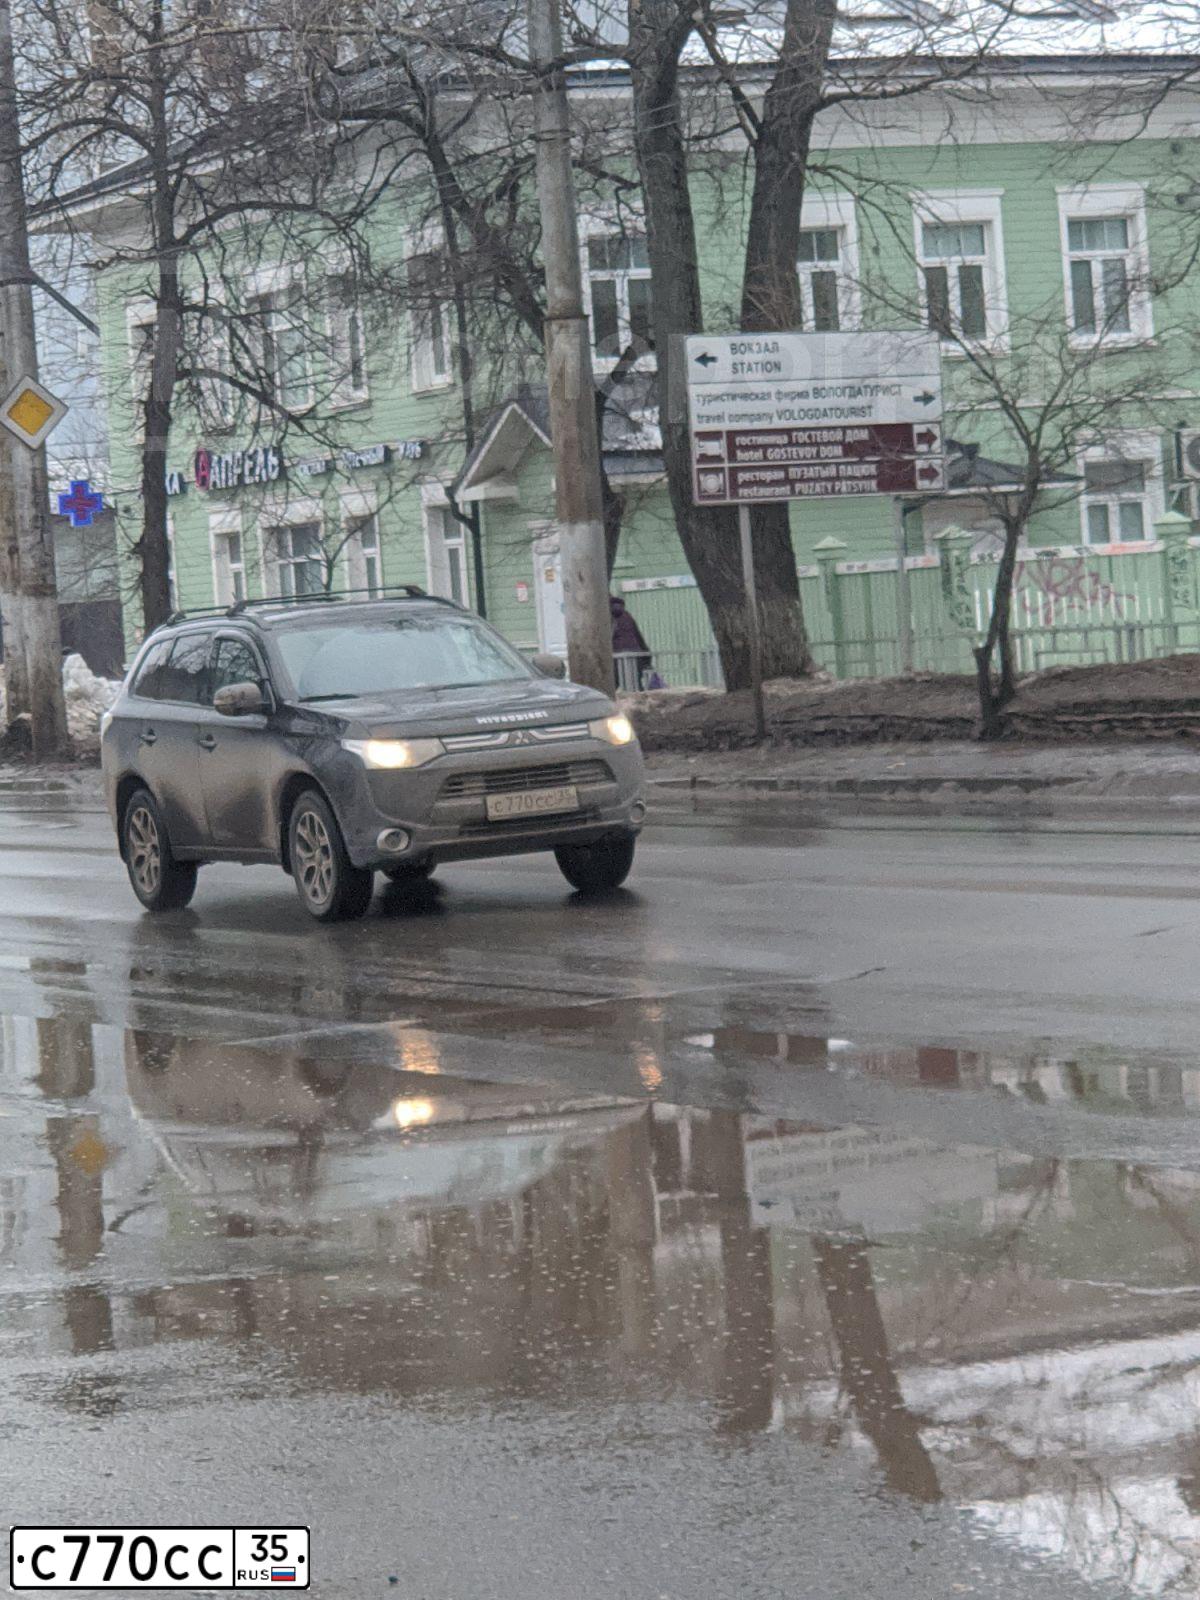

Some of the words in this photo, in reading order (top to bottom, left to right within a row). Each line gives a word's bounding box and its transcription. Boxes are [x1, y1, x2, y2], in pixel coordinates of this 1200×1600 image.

[730, 341, 779, 355] ВОКЗАЛ
[731, 362, 782, 374] STATION
[812, 384, 903, 399] ВОЛОГДАТУРИСТ
[696, 412, 725, 424] travel
[728, 412, 774, 424] company
[776, 405, 873, 421] VOLOGDATOURIST
[791, 428, 843, 443] ГОСТЕВОЙ
[845, 428, 869, 443] ДОМ
[736, 449, 763, 461] hotel
[766, 446, 818, 460] GOSTEVOY
[820, 445, 843, 457] DOM
[737, 471, 785, 485] ресторан
[738, 485, 791, 497] restaurant
[794, 481, 833, 494] PUZATY
